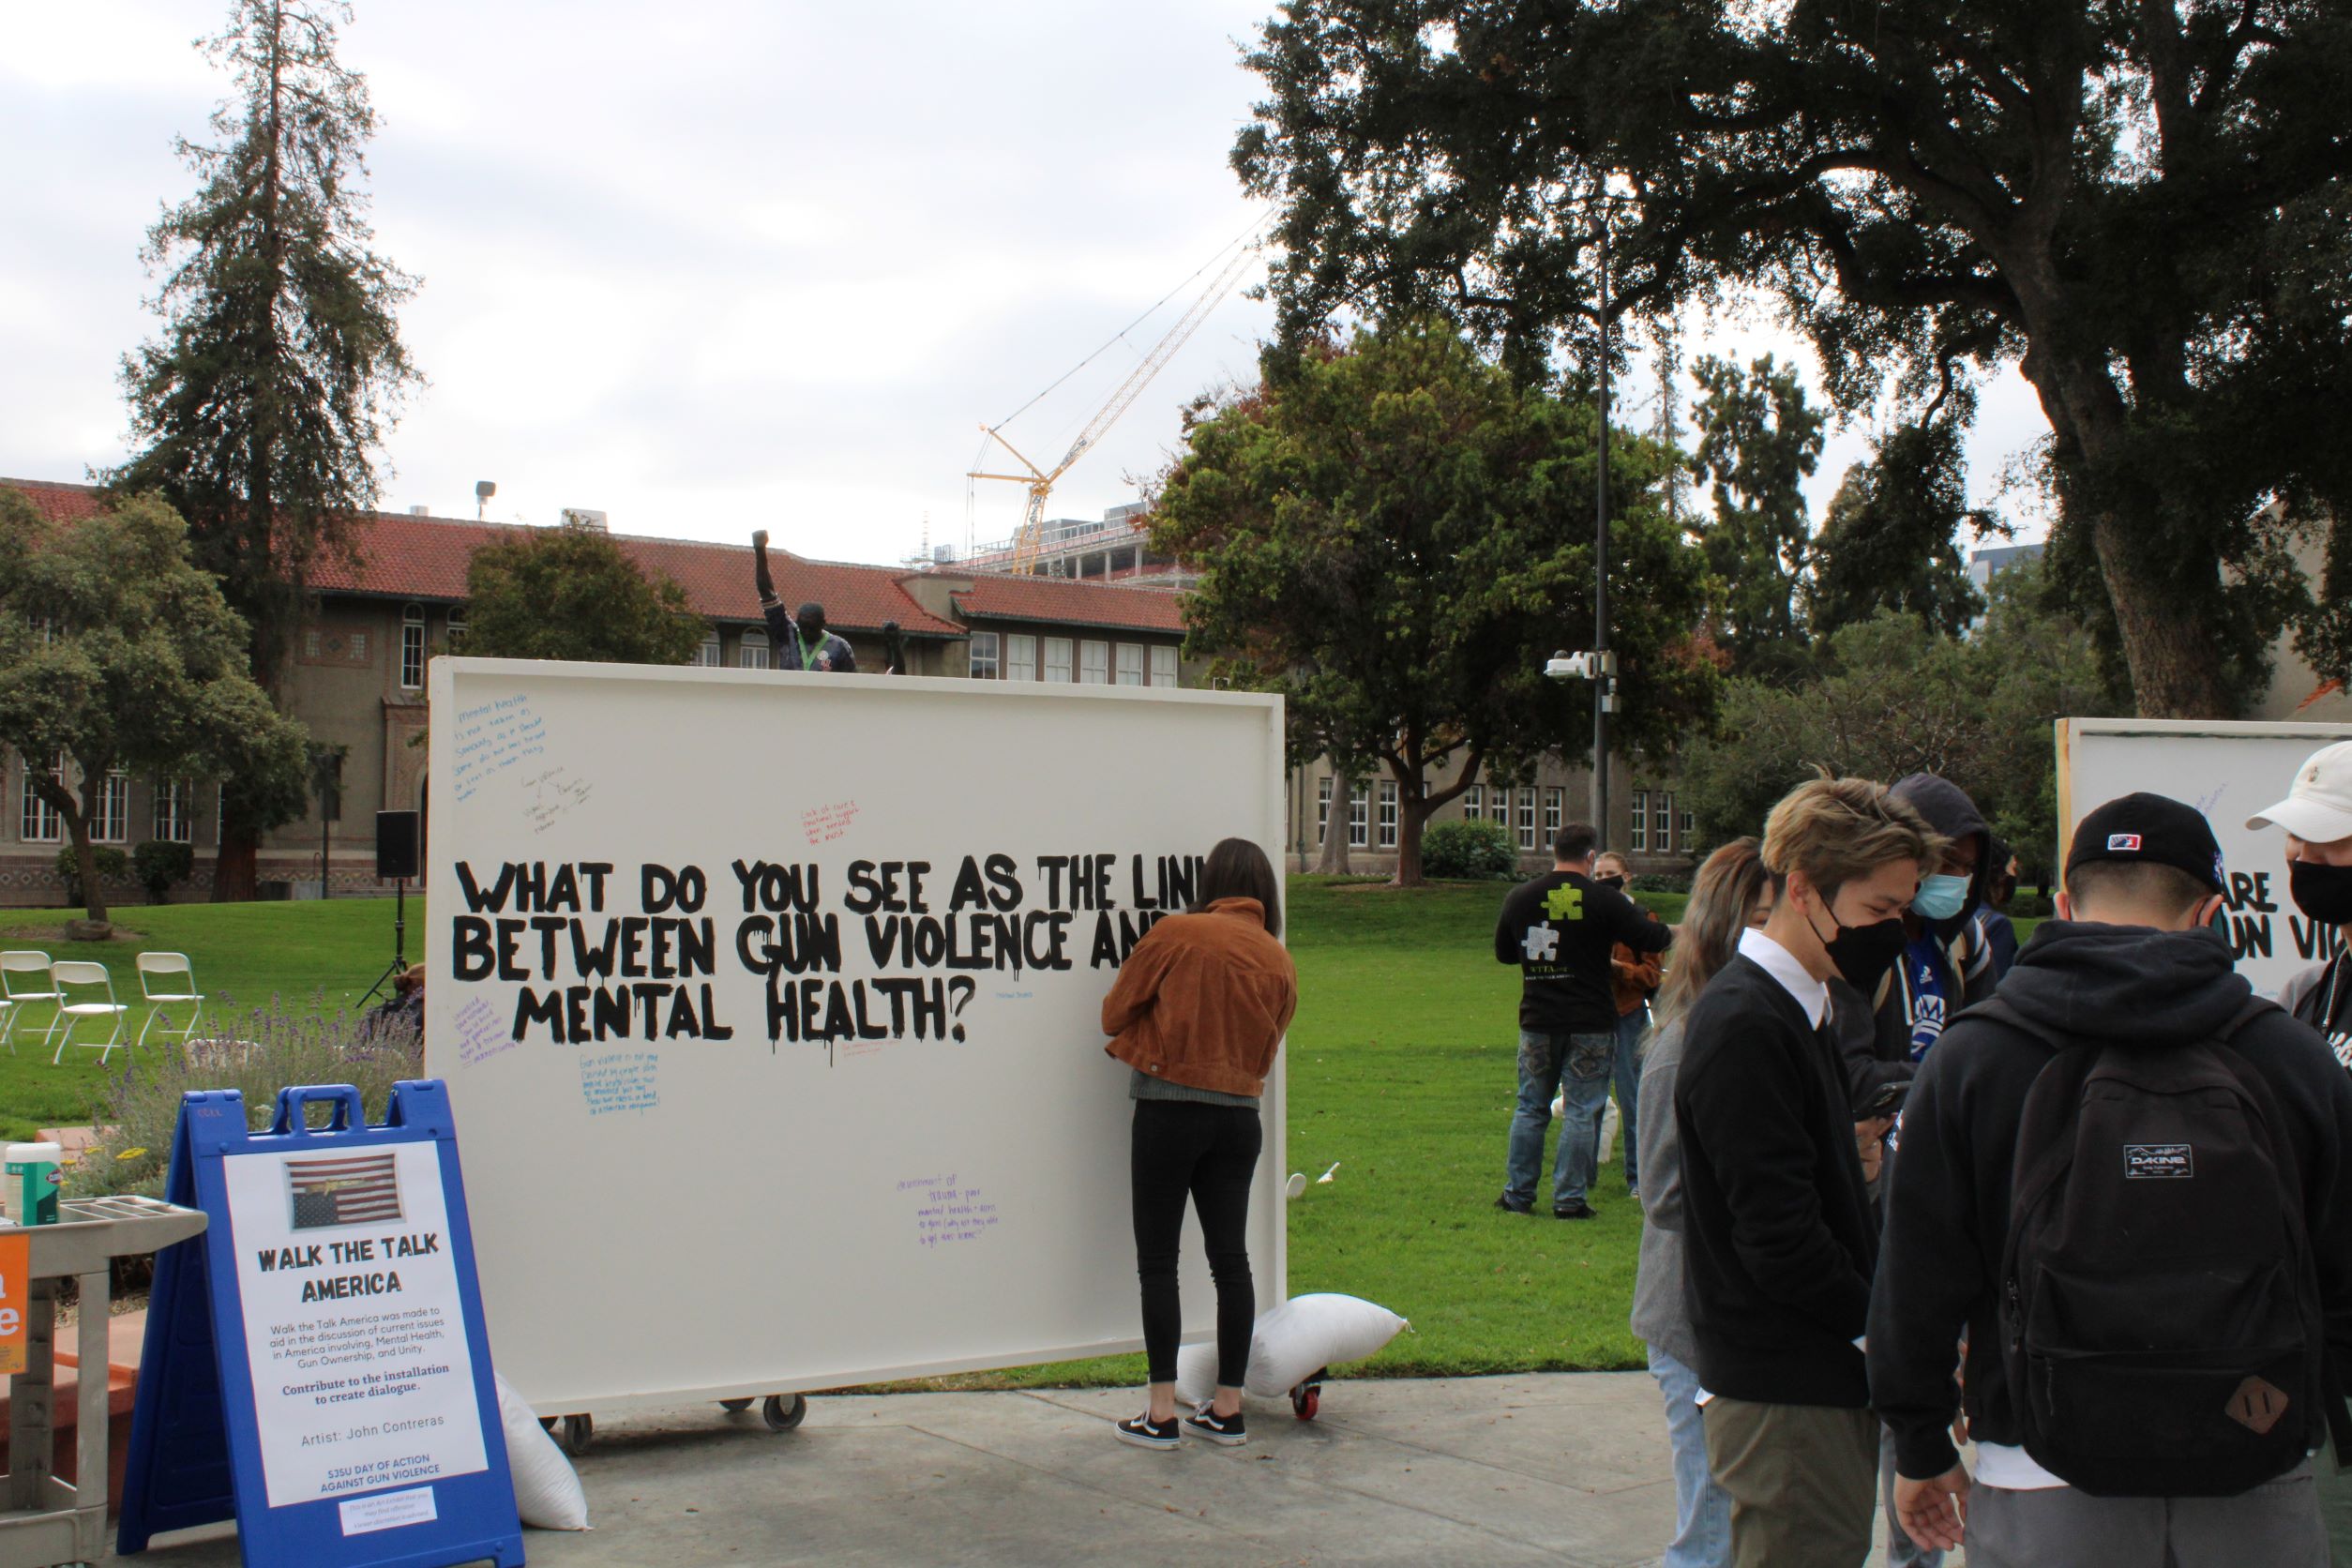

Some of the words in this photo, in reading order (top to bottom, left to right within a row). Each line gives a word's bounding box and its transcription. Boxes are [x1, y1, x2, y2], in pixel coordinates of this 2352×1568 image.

[455, 860, 614, 914] WHAT
[641, 863, 707, 915] DO
[731, 858, 820, 916] YOU
[845, 859, 931, 915] SEE
[949, 853, 1024, 914] AS
[1036, 854, 1120, 913] THE
[453, 915, 716, 983] BETWEEN
[735, 913, 842, 978] GUN
[866, 910, 1074, 975] VIOLENCE
[512, 981, 734, 1046] MENTAL
[765, 975, 976, 1047] HEALTH?
[2130, 1156, 2186, 1165] DAKINE
[258, 1244, 323, 1272] WALK
[329, 1239, 374, 1264] THE
[381, 1232, 439, 1259] TALK
[301, 1271, 402, 1304] AMERICA
[270, 1324, 294, 1335] Walk
[298, 1321, 315, 1332] the
[318, 1319, 338, 1330] Talk
[339, 1315, 379, 1328] America
[381, 1313, 401, 1322] was
[402, 1308, 428, 1319] made
[270, 1337, 285, 1349] aid
[299, 1334, 315, 1343] the
[318, 1328, 366, 1342] discussion
[368, 1324, 379, 1335] of
[381, 1321, 415, 1334] current
[416, 1319, 445, 1330] issues
[273, 1350, 282, 1360] in
[284, 1347, 326, 1359] America
[328, 1341, 373, 1353] involving,
[376, 1335, 409, 1347] Mental
[411, 1330, 445, 1342] Health,
[298, 1359, 319, 1369] Gun
[321, 1351, 375, 1366] Ownership,
[377, 1348, 396, 1358] and
[399, 1345, 426, 1356] Unity.
[282, 1380, 345, 1396] Contribute
[348, 1379, 360, 1387] to
[362, 1374, 382, 1385] the
[384, 1364, 450, 1382] installation
[315, 1395, 326, 1405] to
[329, 1392, 366, 1404] create
[368, 1382, 421, 1397] dialogue.
[301, 1432, 341, 1448] Artist:
[346, 1426, 379, 1440] John
[383, 1415, 445, 1434] Contreras
[321, 1477, 364, 1493] AGAINST
[367, 1472, 390, 1485] GUN
[392, 1464, 441, 1480] VIOLENCE
[354, 1463, 374, 1474] DAY
[377, 1460, 390, 1470] OF
[394, 1454, 430, 1468] ACTION
